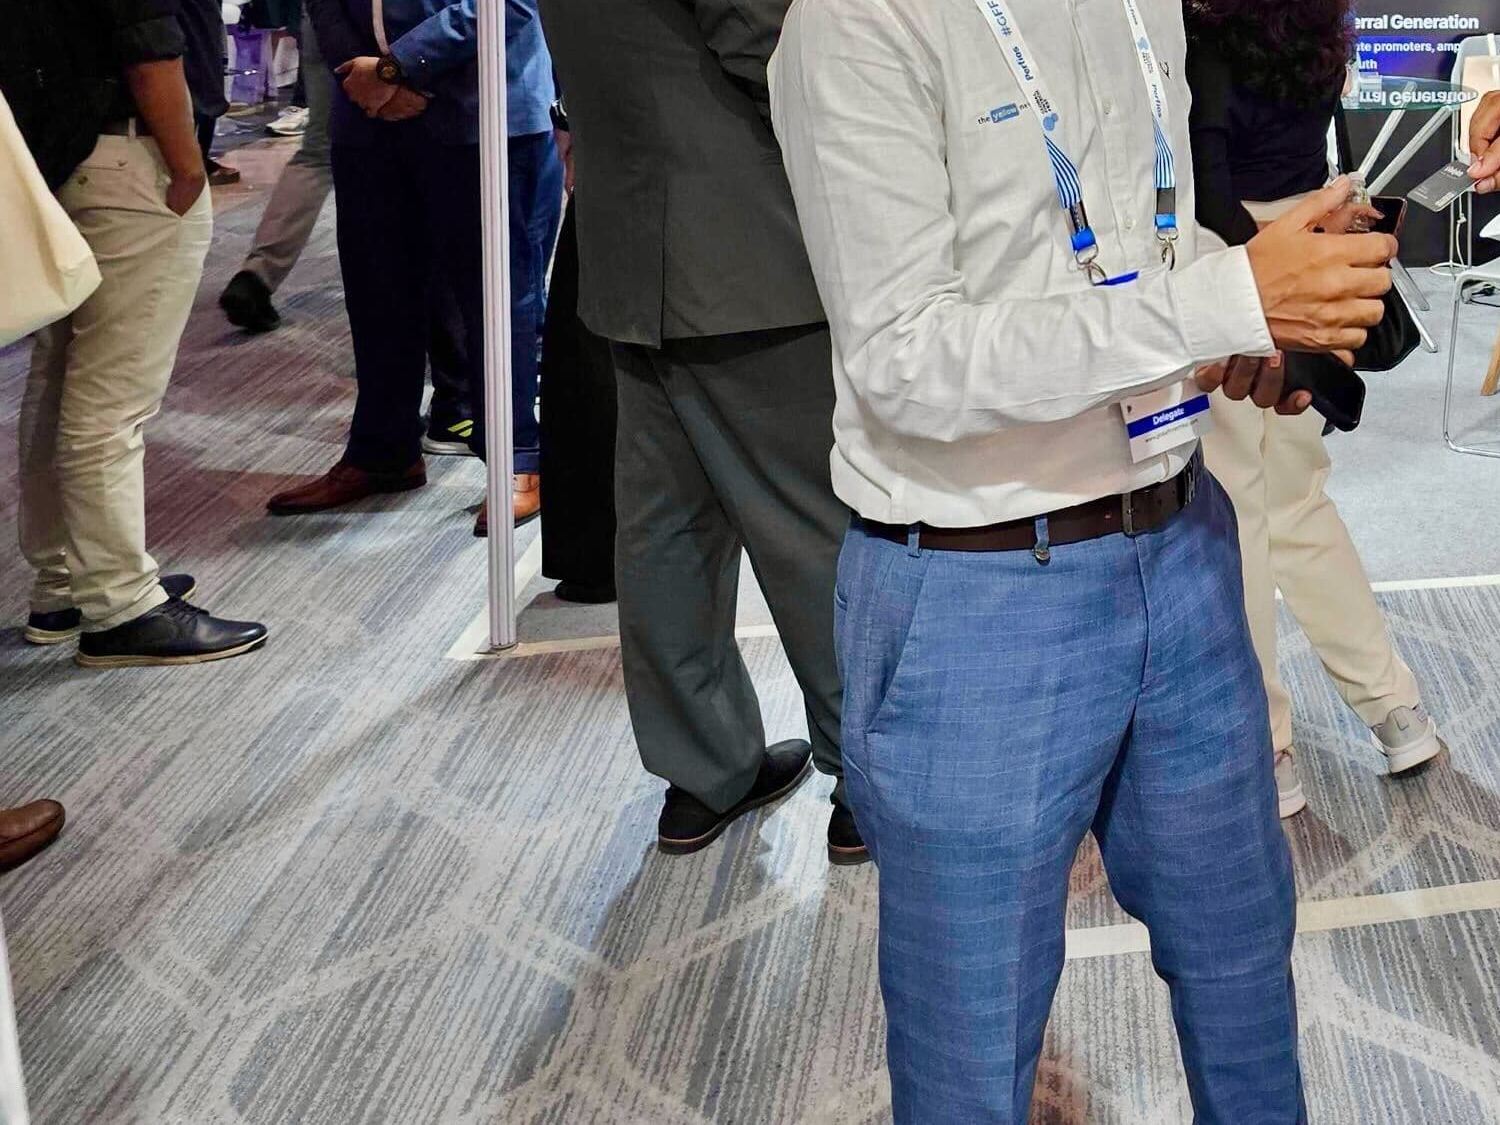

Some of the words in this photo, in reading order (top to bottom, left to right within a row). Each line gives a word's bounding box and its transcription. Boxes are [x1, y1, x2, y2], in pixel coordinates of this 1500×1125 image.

[987, 0, 1012, 36] #GFF
[1355, 15, 1388, 30] erral
[1391, 15, 1479, 30] Generation
[1357, 42, 1371, 53] te
[1373, 43, 1435, 55] promoters,
[1437, 44, 1460, 55] amp
[1012, 46, 1034, 81] Perfios
[978, 115, 991, 125] the
[1152, 407, 1185, 426] Delegate
